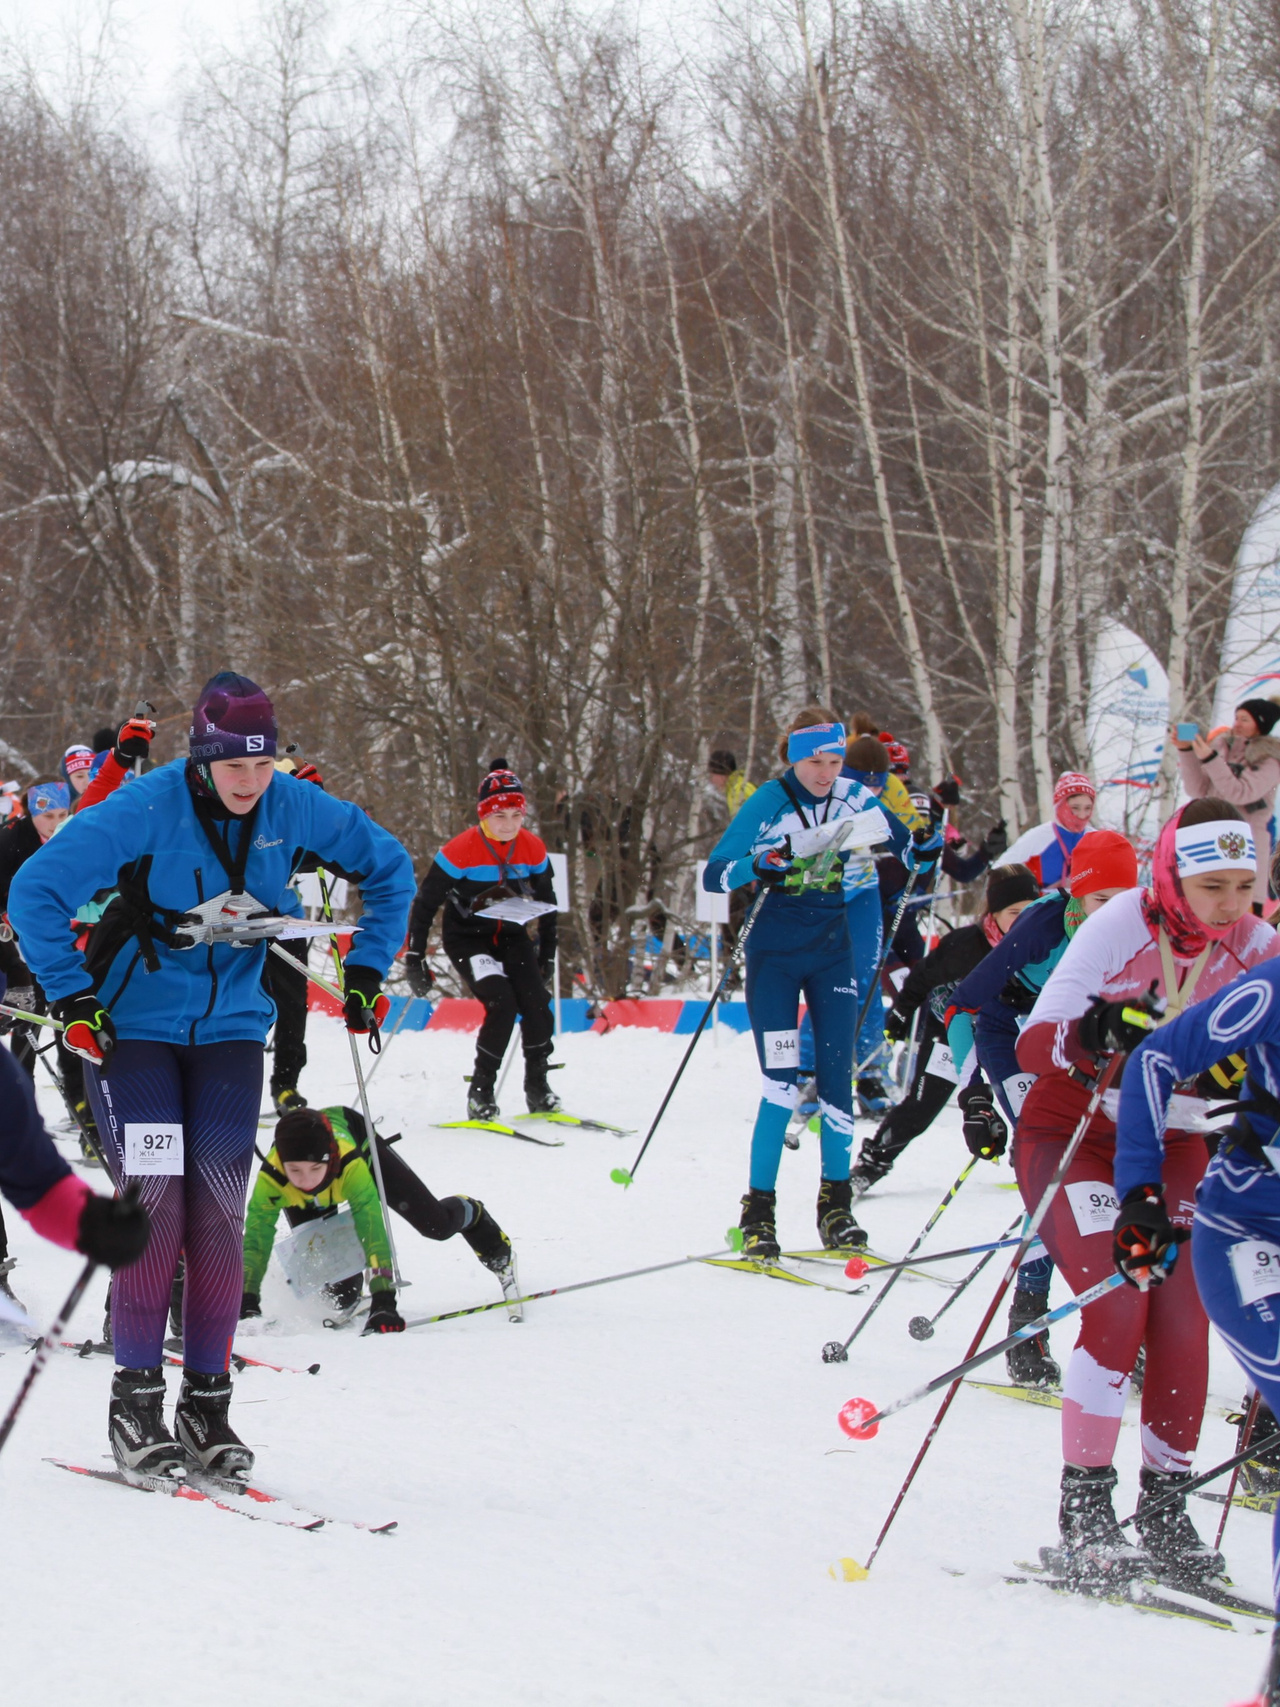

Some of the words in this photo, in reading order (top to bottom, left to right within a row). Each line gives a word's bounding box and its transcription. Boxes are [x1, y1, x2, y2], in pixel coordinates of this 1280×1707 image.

[247, 736, 264, 751] S
[775, 1039, 795, 1051] 944
[143, 1134, 173, 1149] 927
[1089, 1194, 1120, 1211] 926
[190, 1388, 232, 1397] MADSHUS
